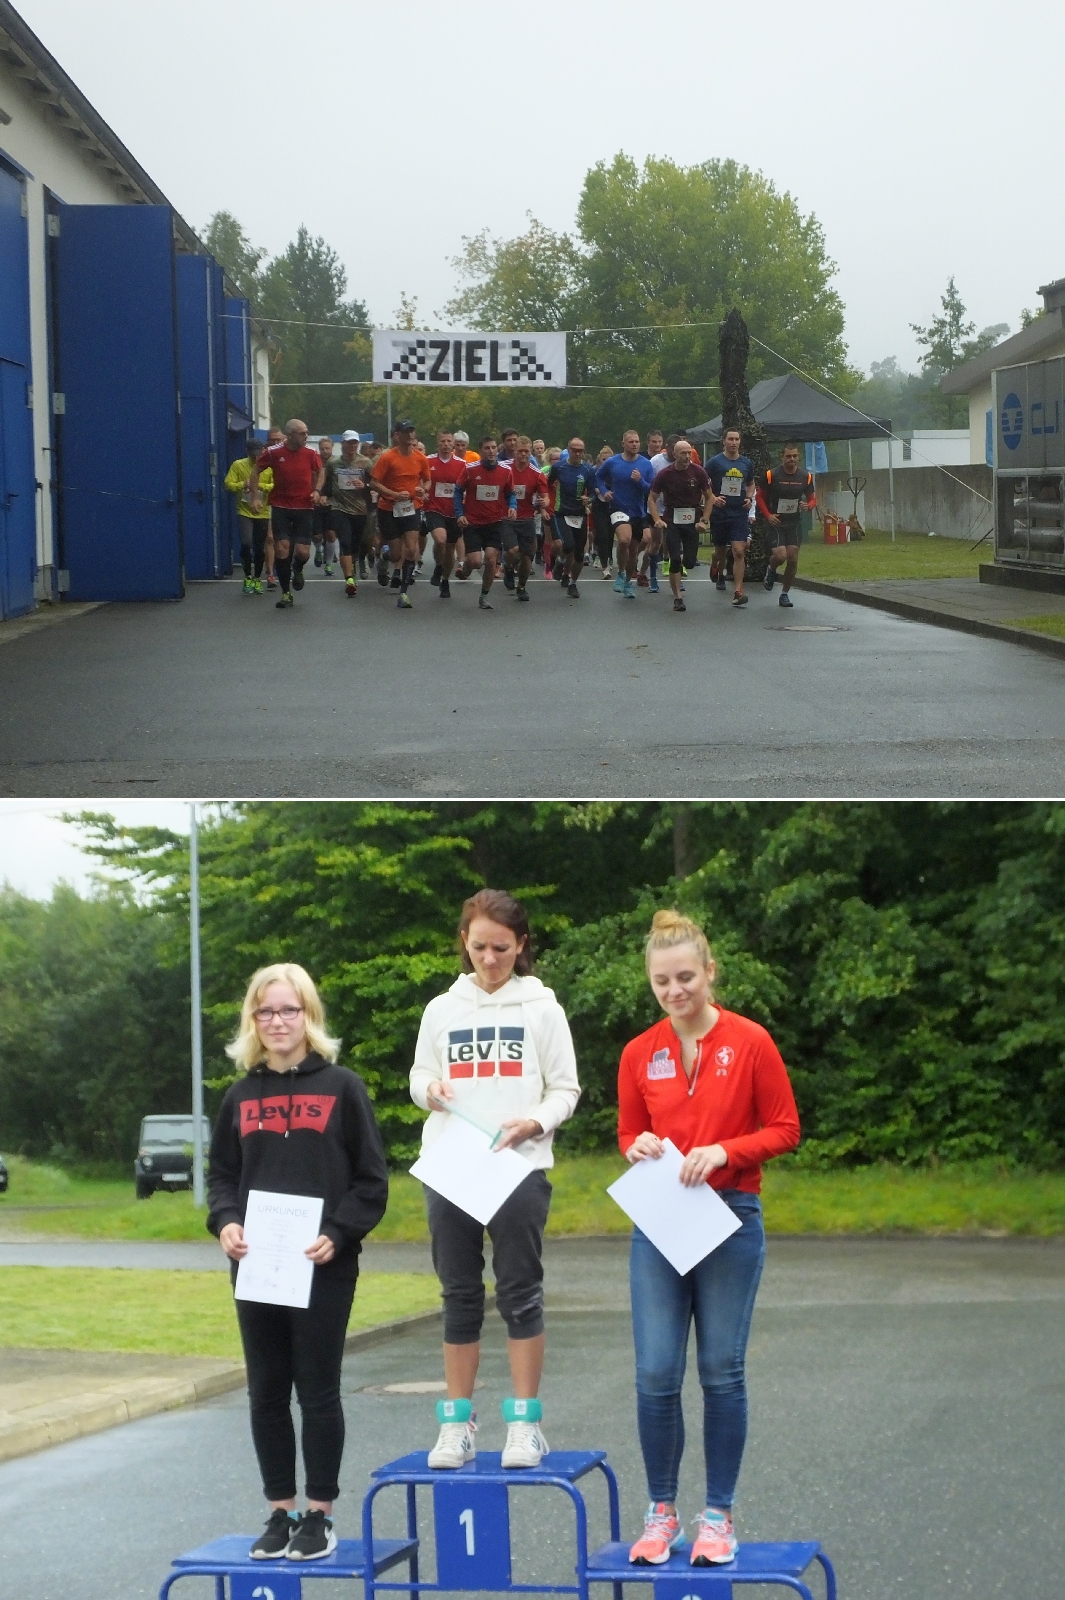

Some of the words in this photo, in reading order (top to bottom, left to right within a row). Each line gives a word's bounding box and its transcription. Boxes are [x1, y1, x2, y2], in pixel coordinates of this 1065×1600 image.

[429, 340, 508, 381] ZIEL
[1031, 400, 1065, 435] CLI
[246, 1101, 322, 1121] Levi's
[257, 1204, 309, 1218] URKUNDE
[458, 1508, 475, 1557] 1
